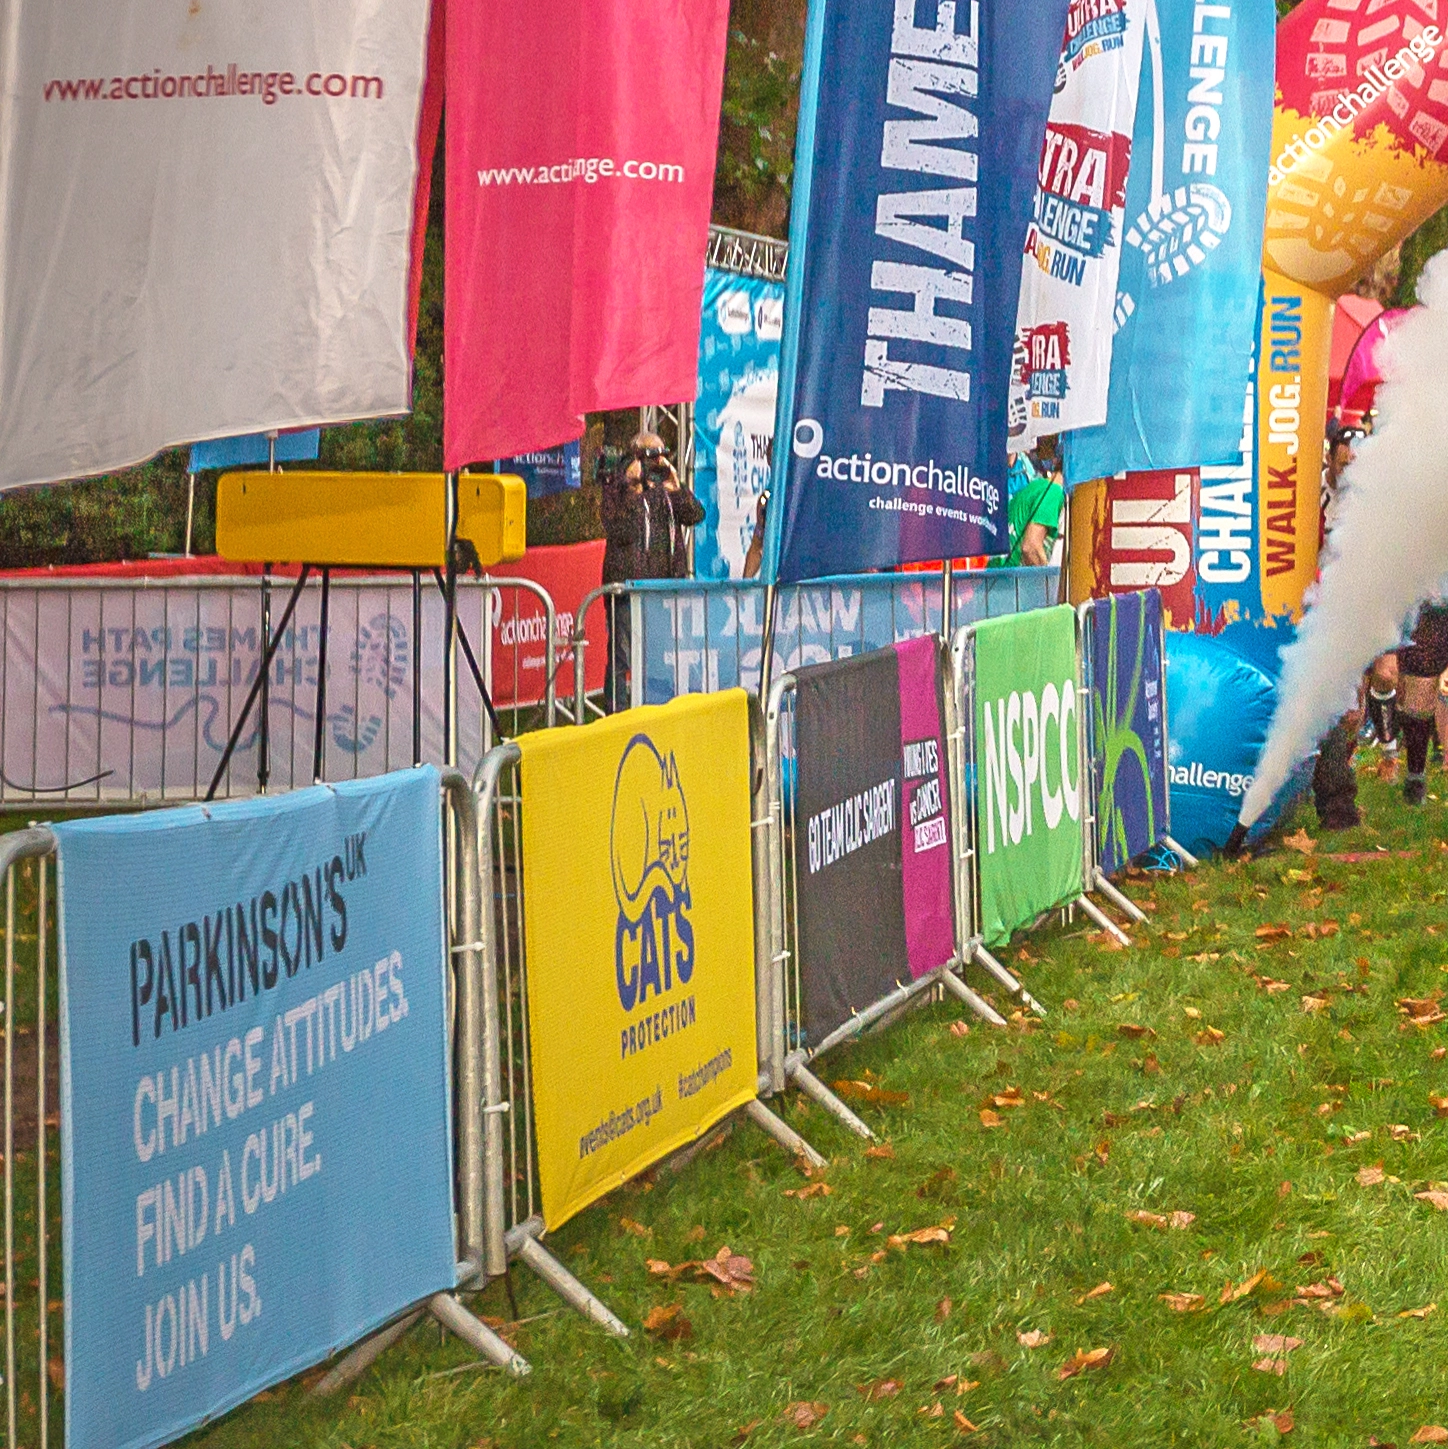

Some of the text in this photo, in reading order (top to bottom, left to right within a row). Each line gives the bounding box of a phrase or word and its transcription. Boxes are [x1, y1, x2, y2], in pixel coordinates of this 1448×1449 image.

[1268, 24, 1443, 186] actionchallenge
[816, 452, 1000, 514] actionchallenge
[868, 495, 968, 522] challenge events
[808, 778, 896, 875] GO TEAM CLIC SARGENT
[982, 677, 1081, 854] NSPCC
[128, 832, 369, 1049] PARKINSON'S UK
[615, 887, 696, 1013] CATS
[133, 948, 411, 1165] CHANGE ATTITUDES.
[620, 994, 696, 1060] PROTECTION
[135, 1100, 323, 1281] FIND A CURE.
[135, 1240, 263, 1394] JOIN US.
